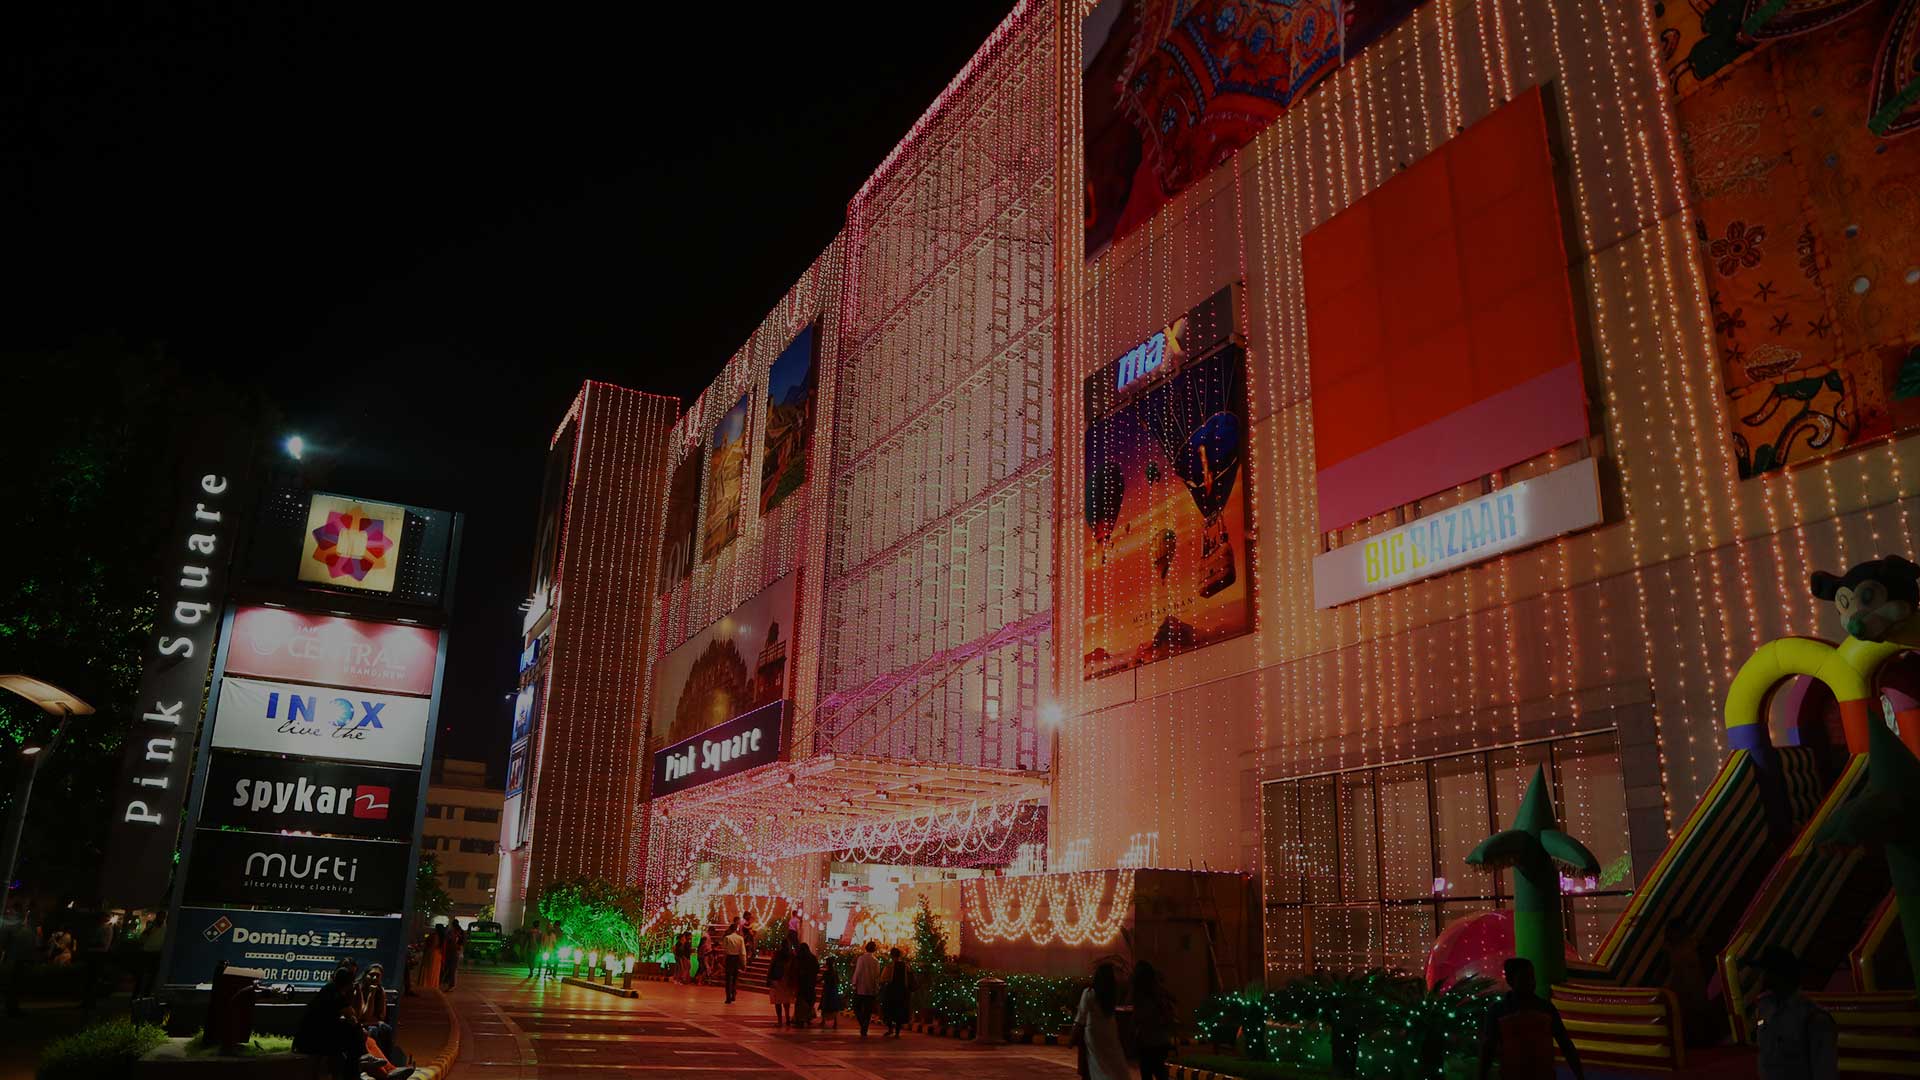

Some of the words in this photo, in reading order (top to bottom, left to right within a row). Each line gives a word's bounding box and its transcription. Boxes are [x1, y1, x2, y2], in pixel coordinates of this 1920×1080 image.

[1117, 317, 1185, 392] max
[1364, 532, 1404, 584] BIG
[1410, 493, 1517, 570] BAZAAR
[124, 700, 184, 826] Pink
[158, 472, 228, 658] Square
[287, 634, 406, 671] CETRAL
[266, 692, 386, 729] INOX
[277, 719, 326, 737] live
[330, 724, 371, 741] the
[664, 745, 696, 782] Pink
[701, 727, 762, 772] Square
[232, 777, 353, 815] spykar
[244, 880, 305, 890] alternative
[309, 884, 353, 894] clothing
[232, 927, 322, 947] Domino's
[327, 932, 378, 949] Pizza
[281, 968, 310, 981] FOOD
